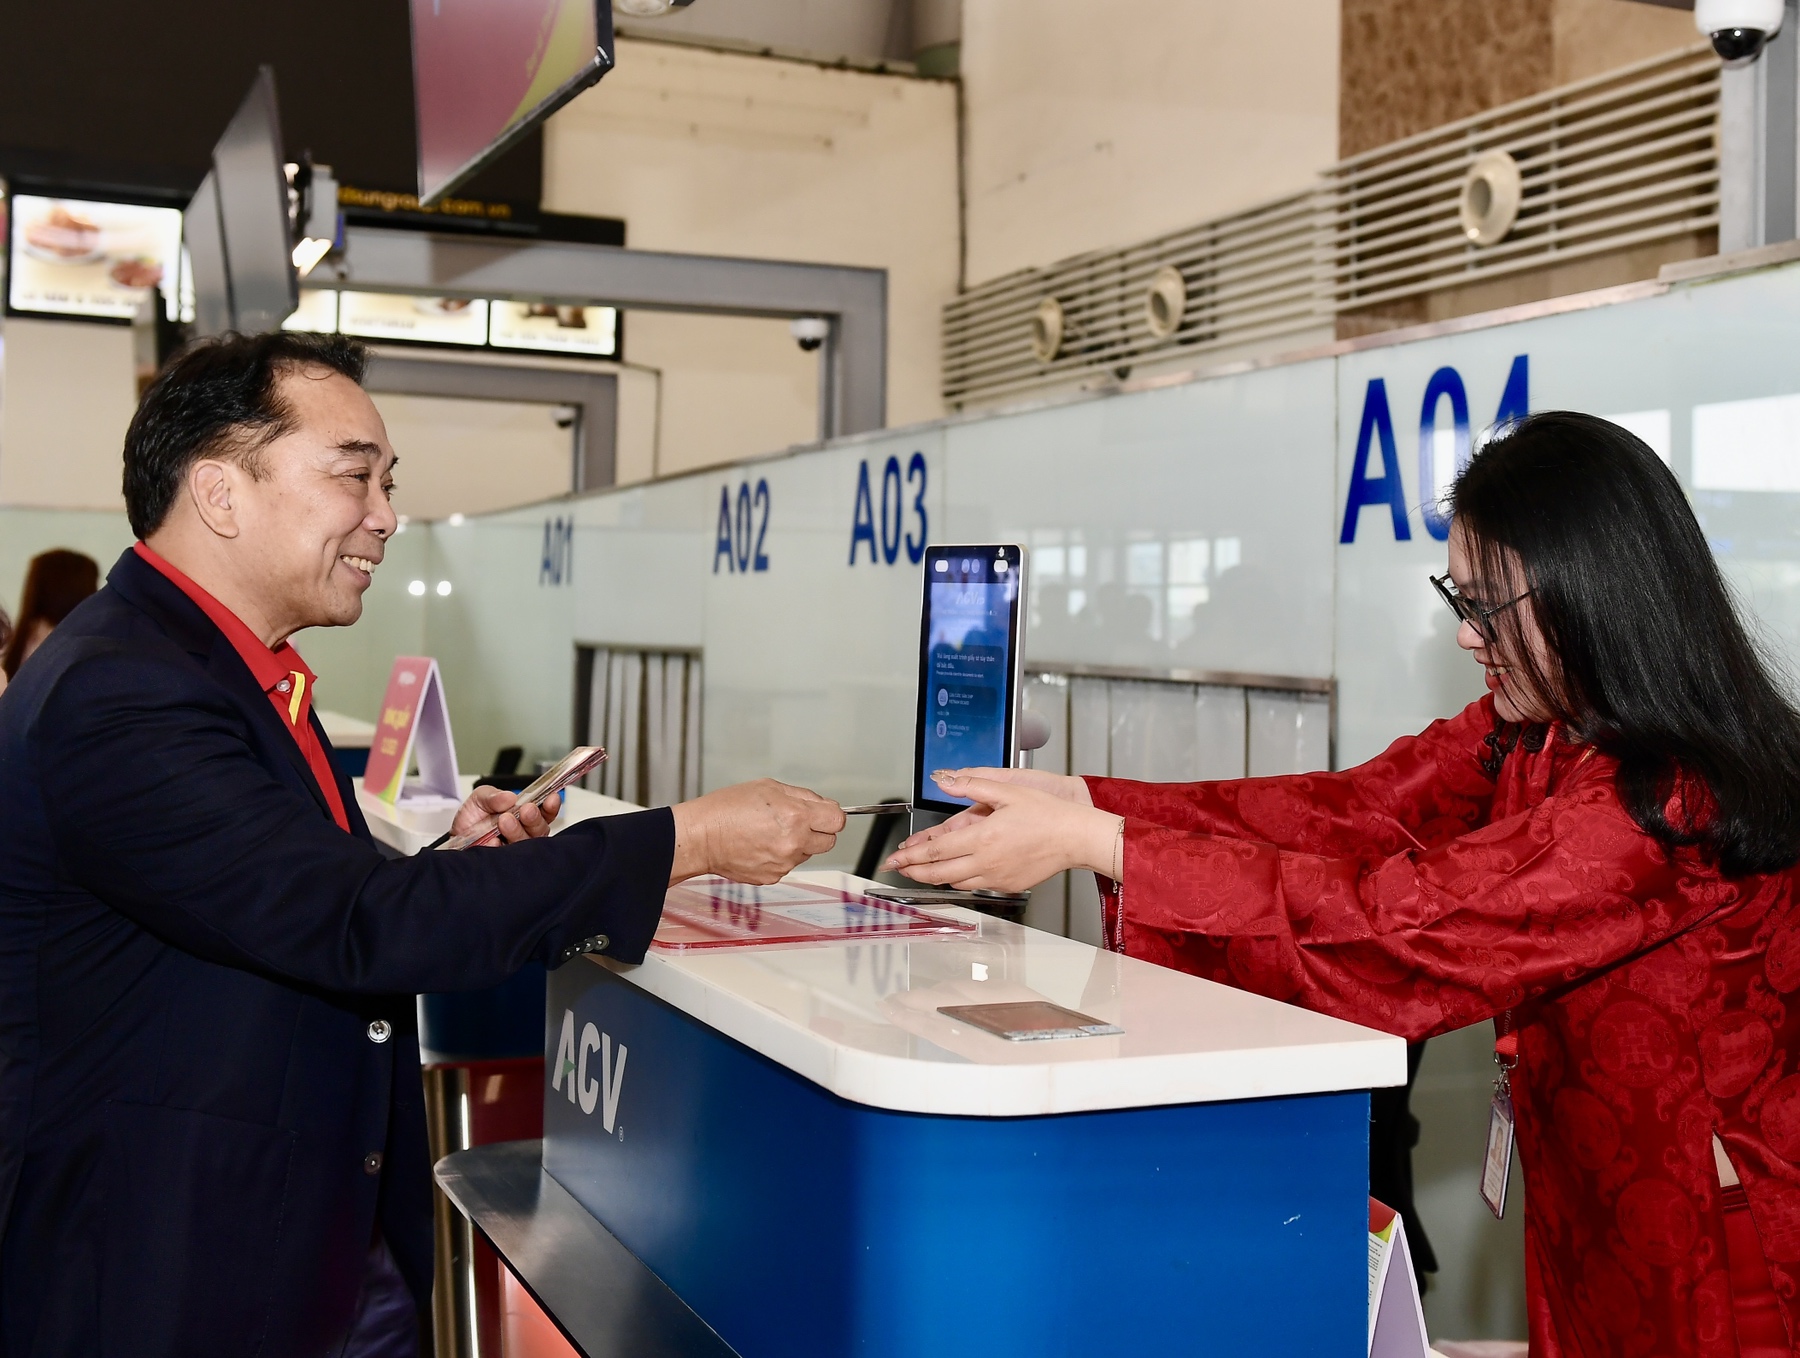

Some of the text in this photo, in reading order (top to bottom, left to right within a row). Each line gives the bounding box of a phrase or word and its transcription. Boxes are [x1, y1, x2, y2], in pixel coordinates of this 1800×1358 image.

[540, 515, 573, 587] A01
[713, 478, 770, 574] A02
[848, 451, 928, 566] A03
[552, 1008, 627, 1135] ACV
